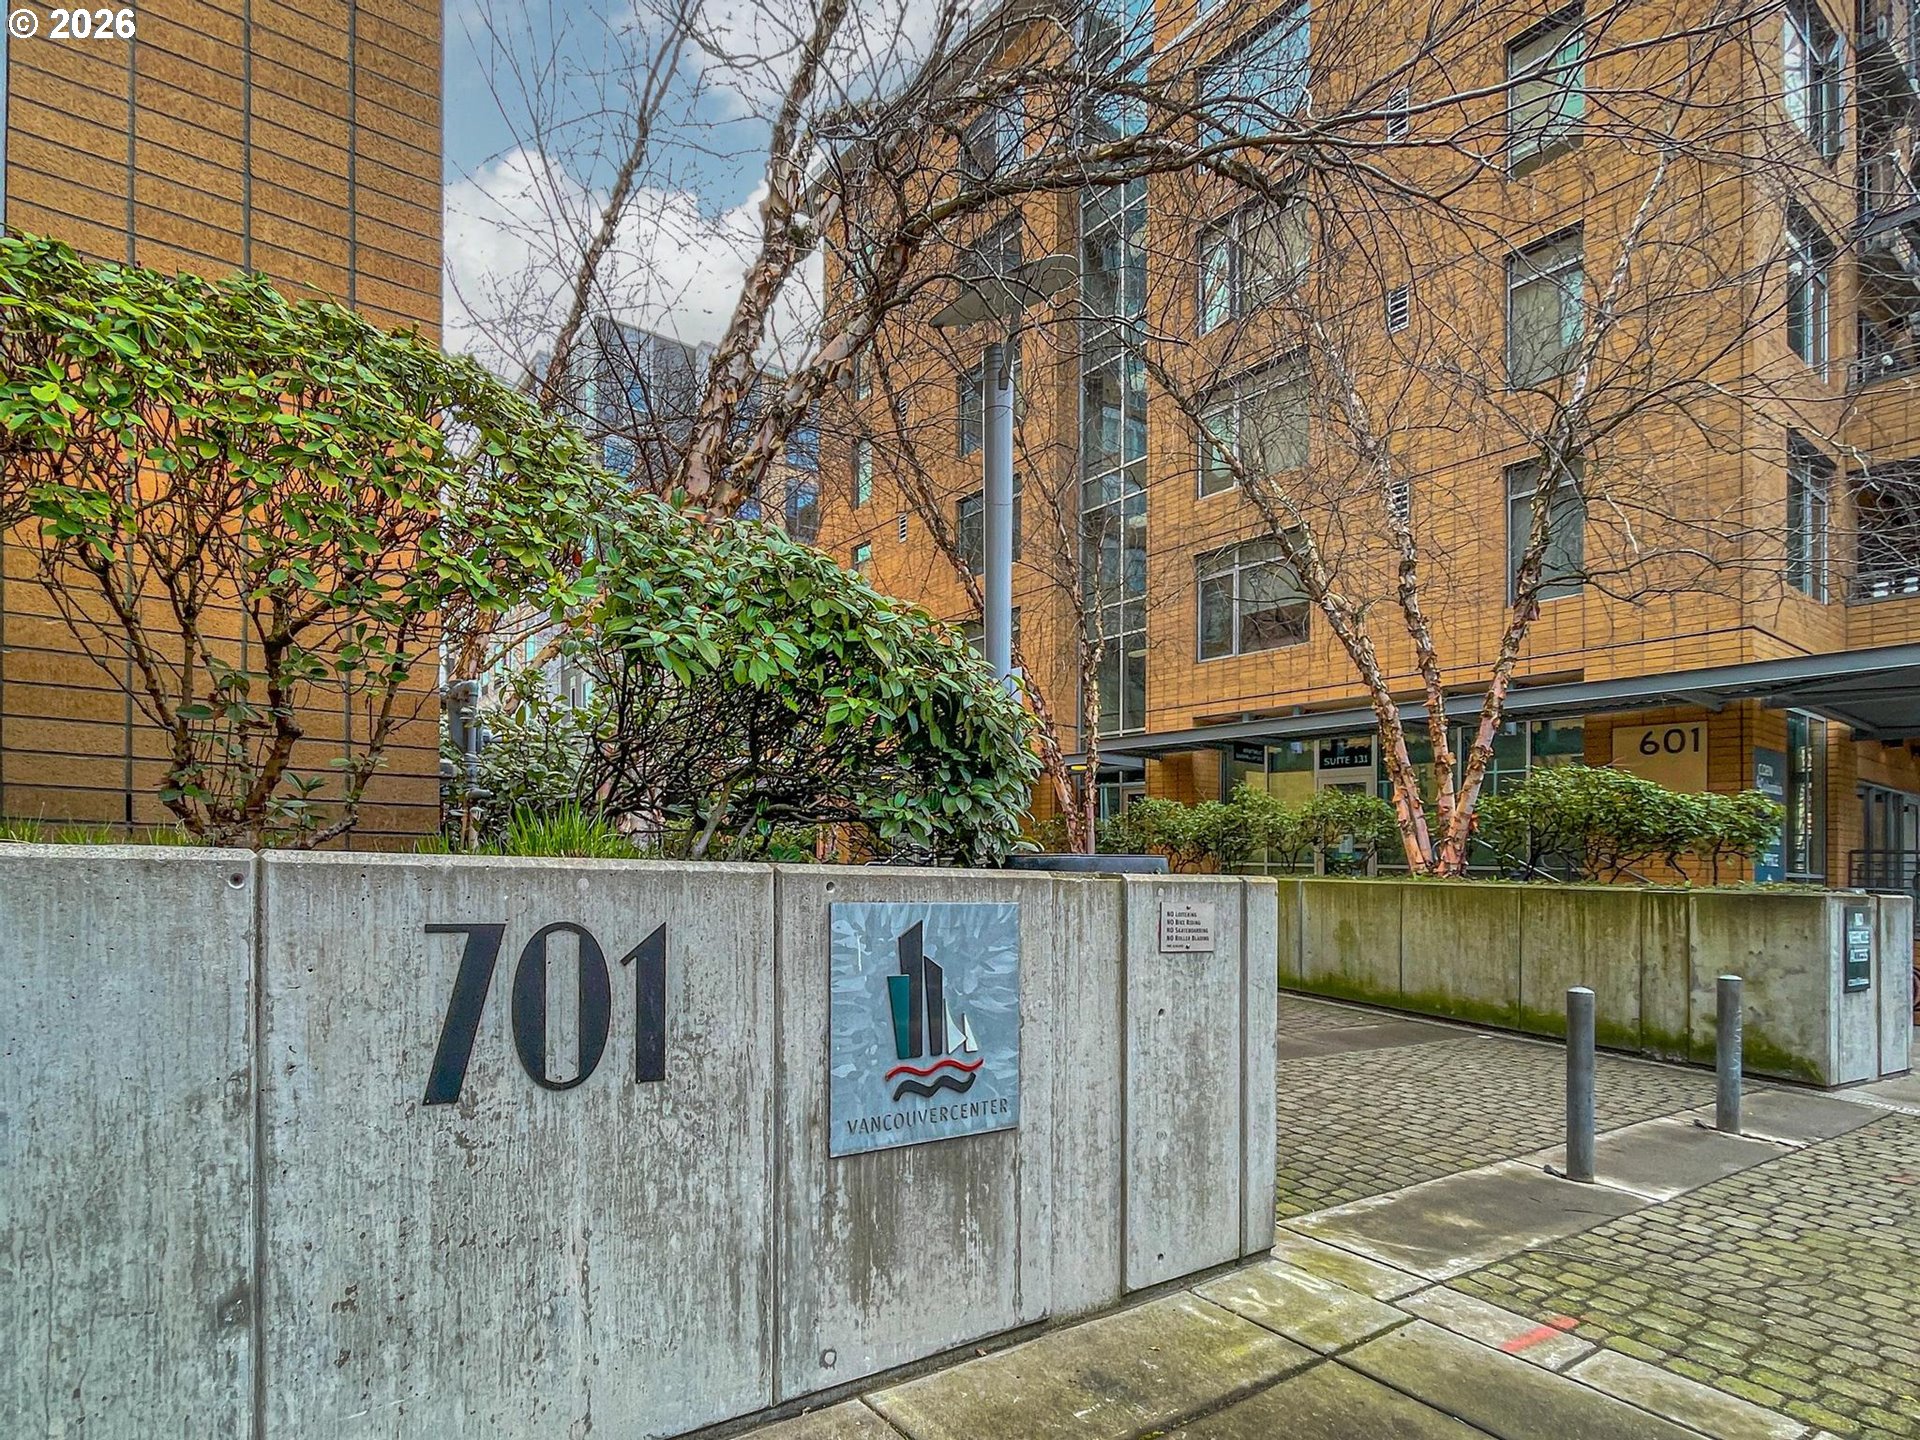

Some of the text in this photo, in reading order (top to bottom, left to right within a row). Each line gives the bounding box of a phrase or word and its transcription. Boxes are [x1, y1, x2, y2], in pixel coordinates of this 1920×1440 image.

[1639, 727, 1700, 755] 601
[1323, 755, 1368, 766] SUITE 131
[422, 921, 666, 1107] 701
[847, 1098, 1008, 1136] VANCOUVERCENTER
